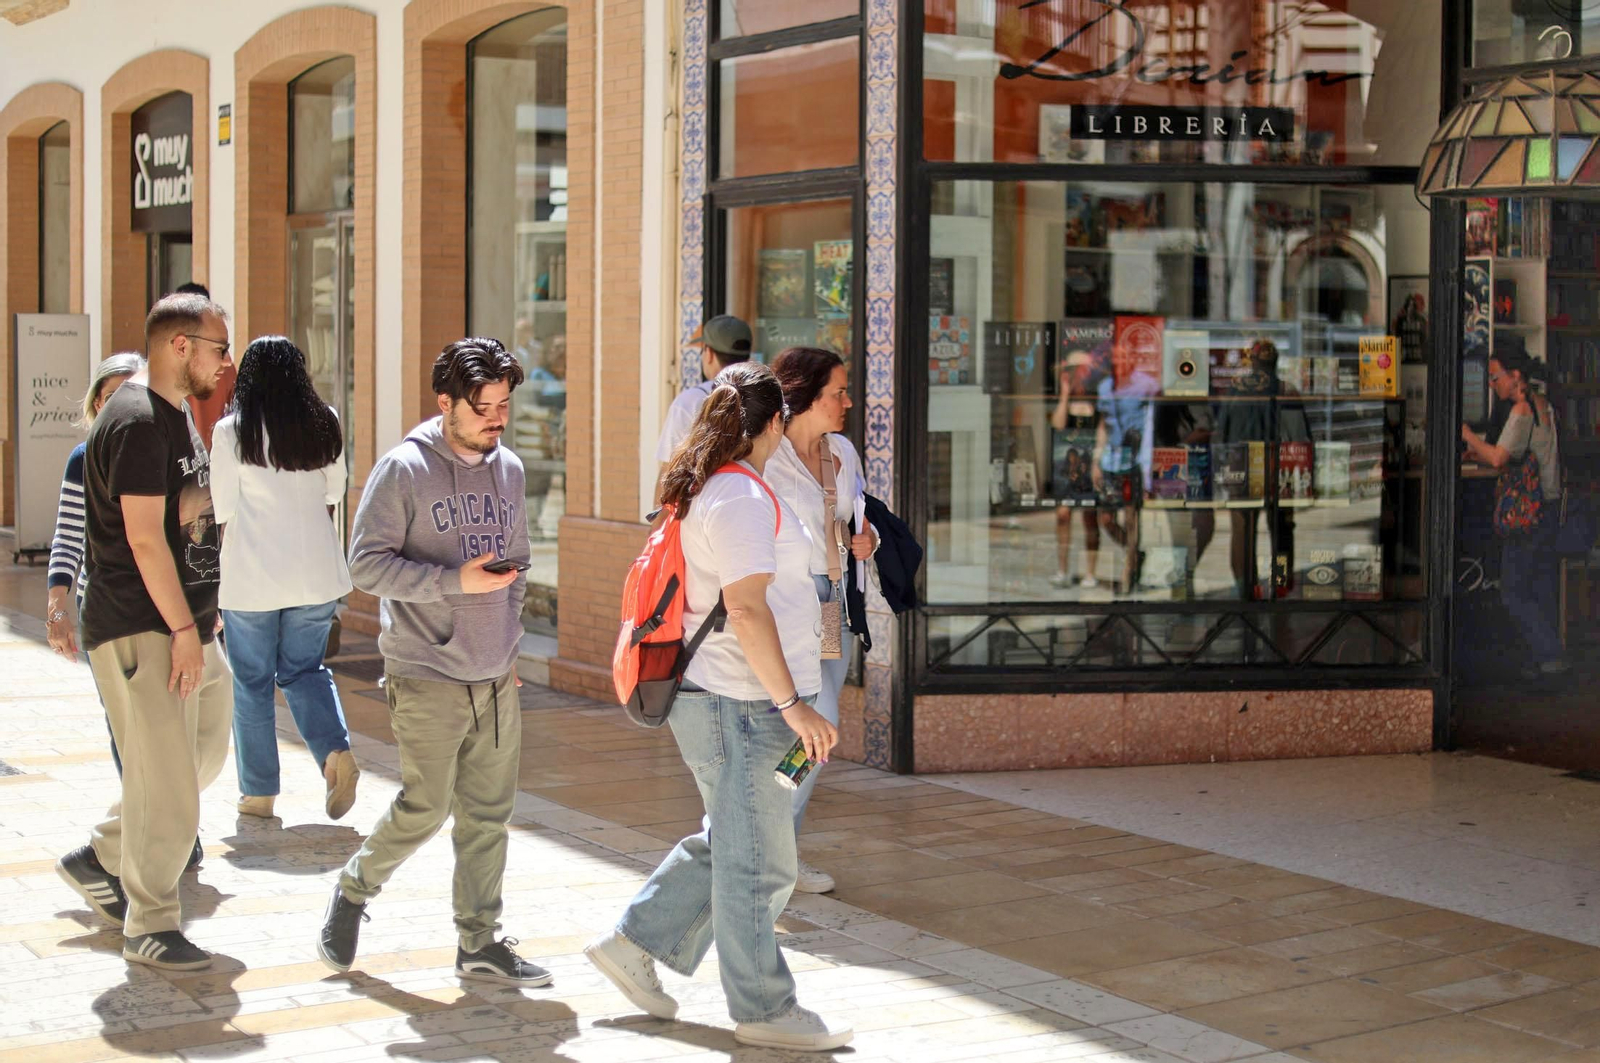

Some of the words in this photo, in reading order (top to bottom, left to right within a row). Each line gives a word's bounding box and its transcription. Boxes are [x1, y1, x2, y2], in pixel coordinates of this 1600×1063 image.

[1088, 113, 1277, 136] LIBRERÍA
[153, 133, 189, 171] muy
[820, 244, 849, 259] HEAT
[37, 330, 53, 338] muy
[32, 372, 69, 388] nice
[32, 390, 46, 407] &
[29, 406, 78, 428] price
[430, 492, 517, 534] CHICAGO
[460, 532, 508, 561] 1976
